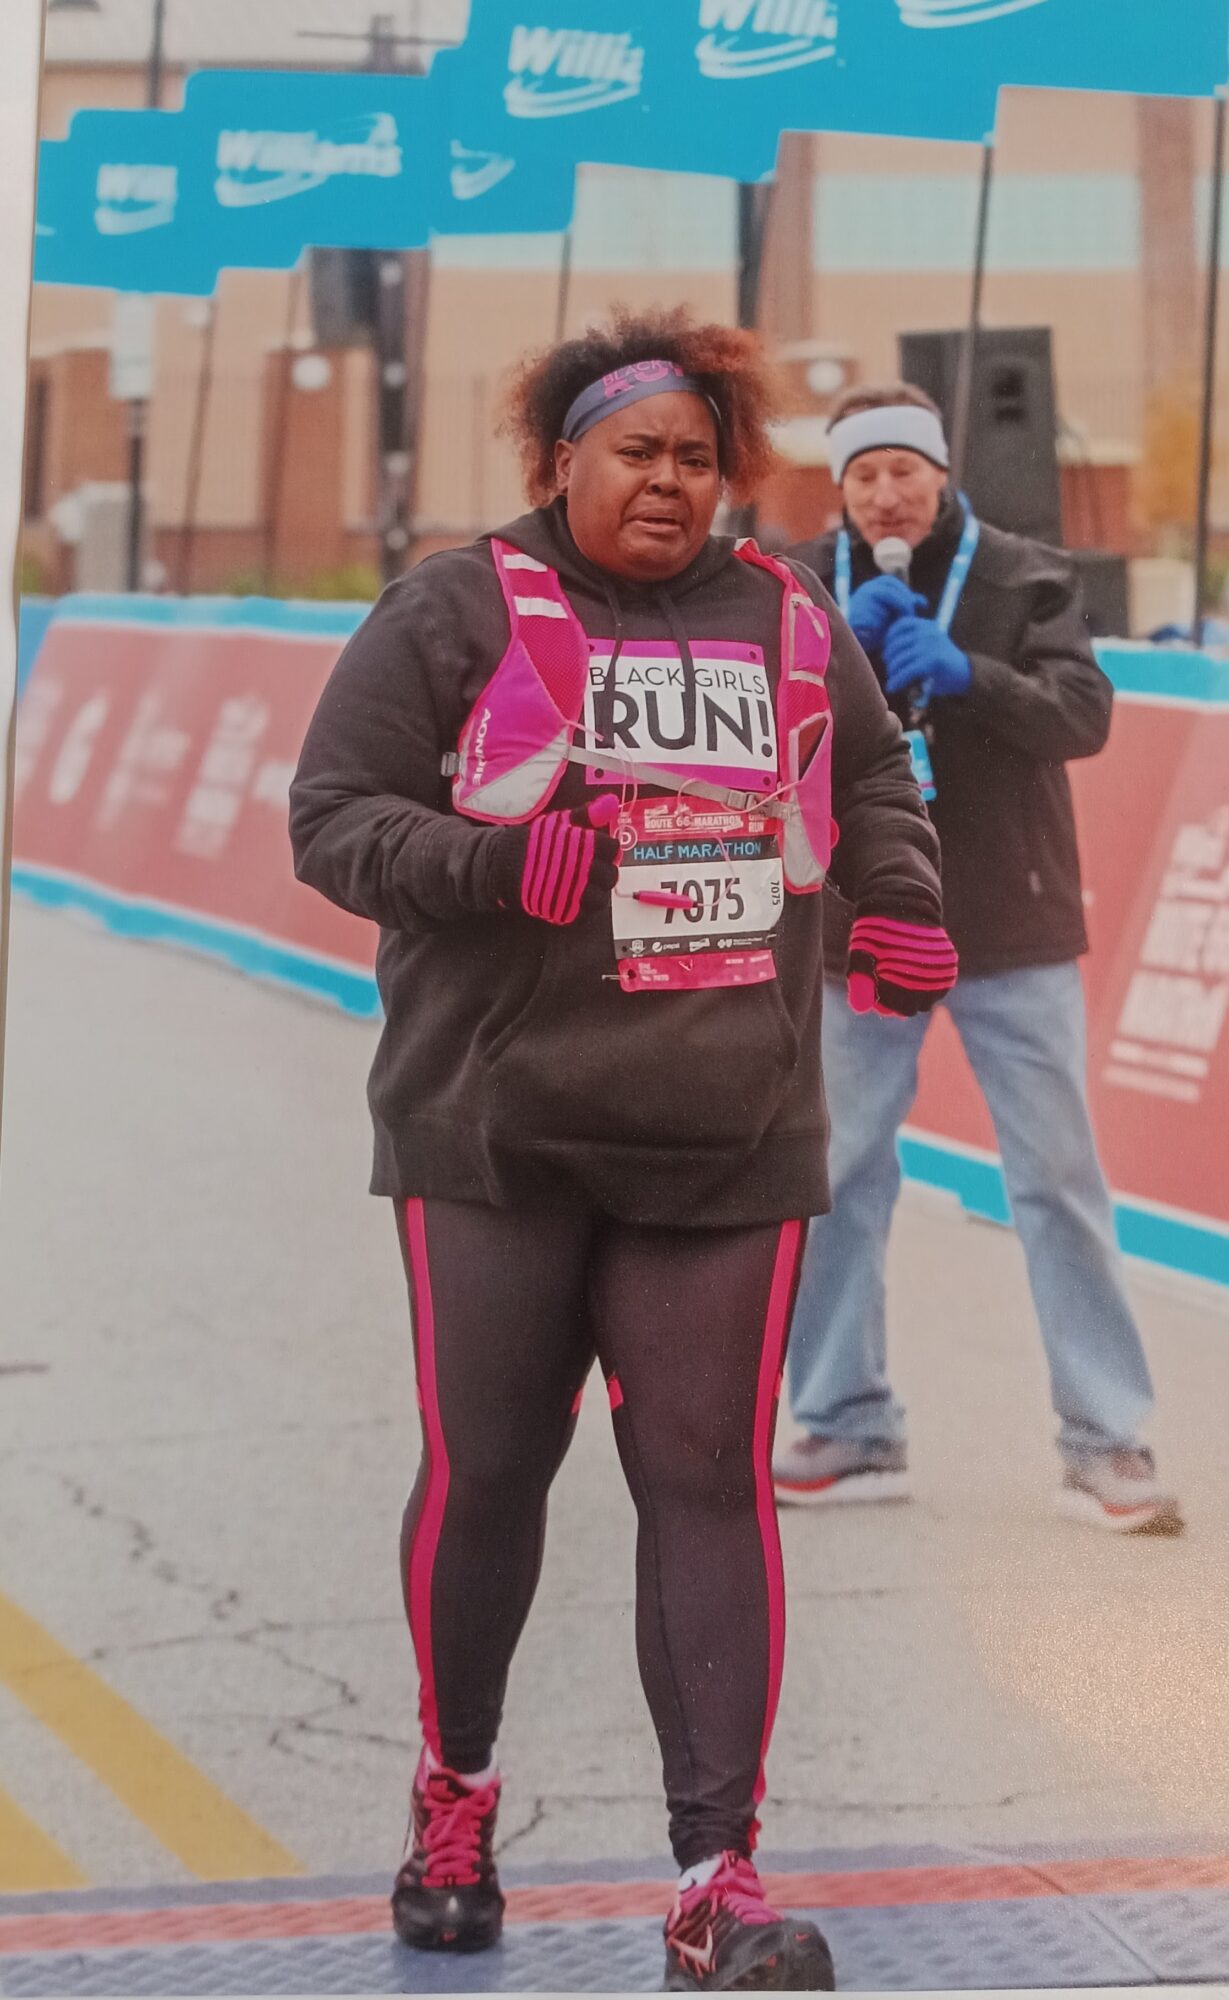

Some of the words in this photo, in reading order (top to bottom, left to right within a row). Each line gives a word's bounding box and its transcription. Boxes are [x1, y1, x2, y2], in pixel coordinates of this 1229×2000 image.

[694, 668, 766, 695] GIRLS
[592, 690, 773, 757] RUN!
[633, 845, 673, 861] HALF
[678, 841, 762, 858] MARATHON
[660, 877, 745, 925] 7075
[770, 880, 780, 906] 7075
